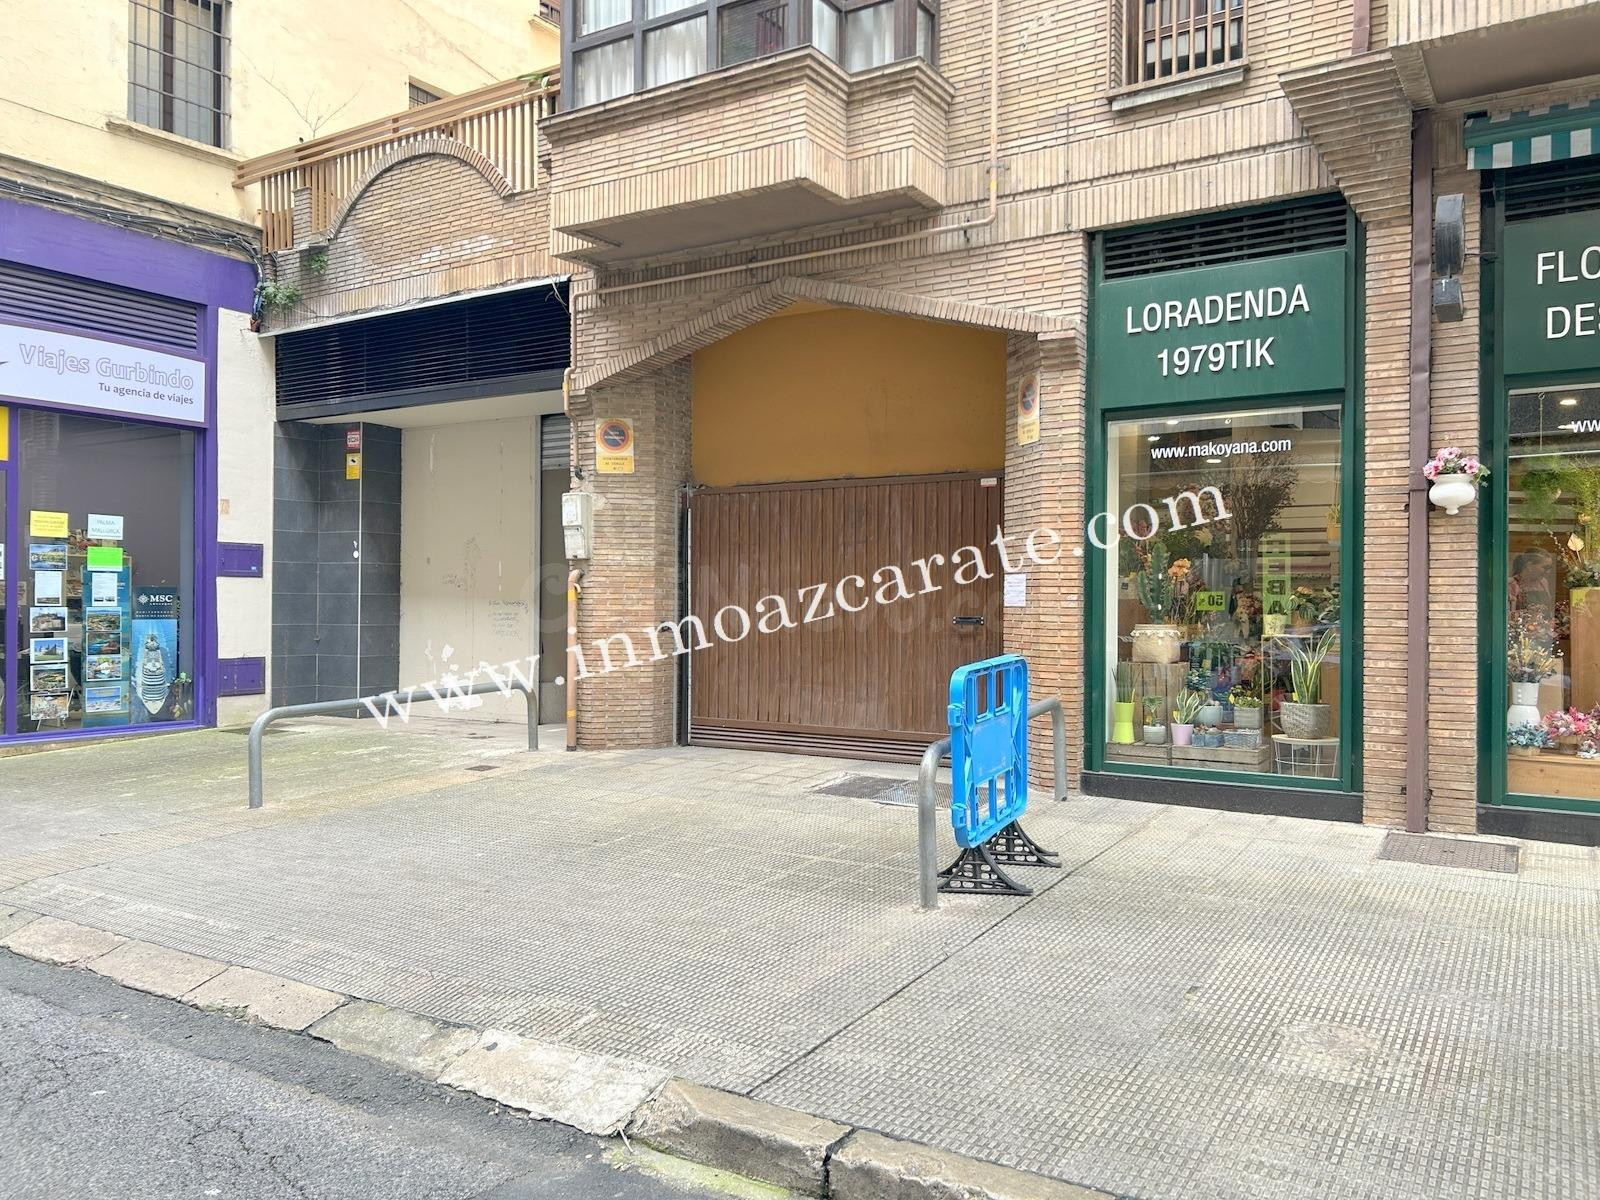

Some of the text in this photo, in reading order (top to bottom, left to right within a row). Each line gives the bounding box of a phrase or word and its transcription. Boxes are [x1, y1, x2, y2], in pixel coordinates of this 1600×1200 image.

[1126, 284, 1310, 334] LORADENDA
[1546, 302, 1600, 339] DE
[19, 343, 193, 390] Viajes Gurbindo
[1157, 336, 1275, 377] 1979TIK
[98, 382, 194, 405] Tu agencia de viajes
[1151, 439, 1292, 459] www.makoyana.com
[150, 594, 173, 603] MSC
